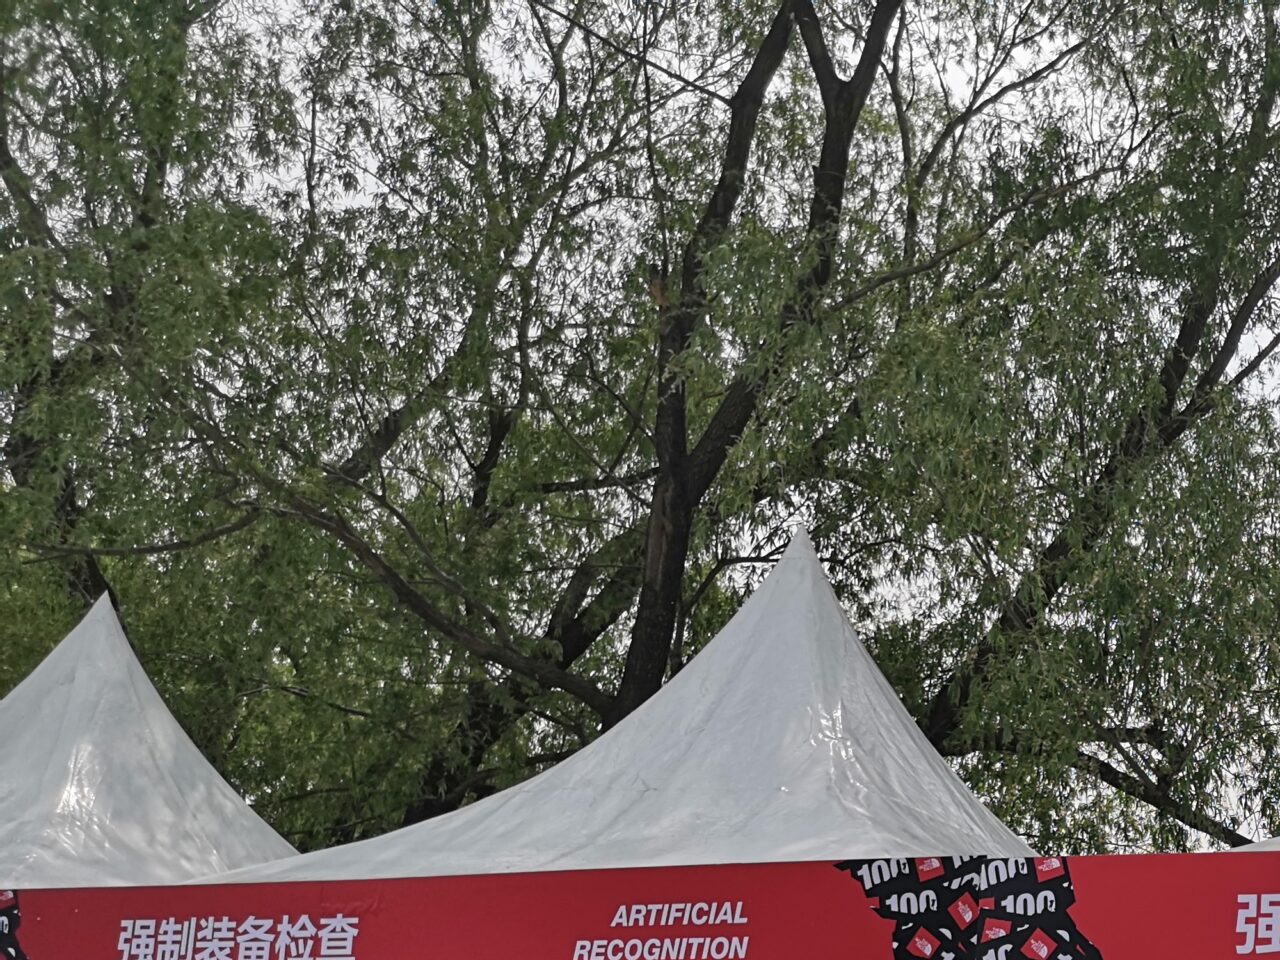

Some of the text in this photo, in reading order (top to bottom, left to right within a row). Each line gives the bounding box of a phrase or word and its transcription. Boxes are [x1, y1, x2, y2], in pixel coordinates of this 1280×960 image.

[611, 901, 748, 927] ARTIFICIAL
[885, 889, 938, 915] 100
[1001, 890, 1056, 916] 100
